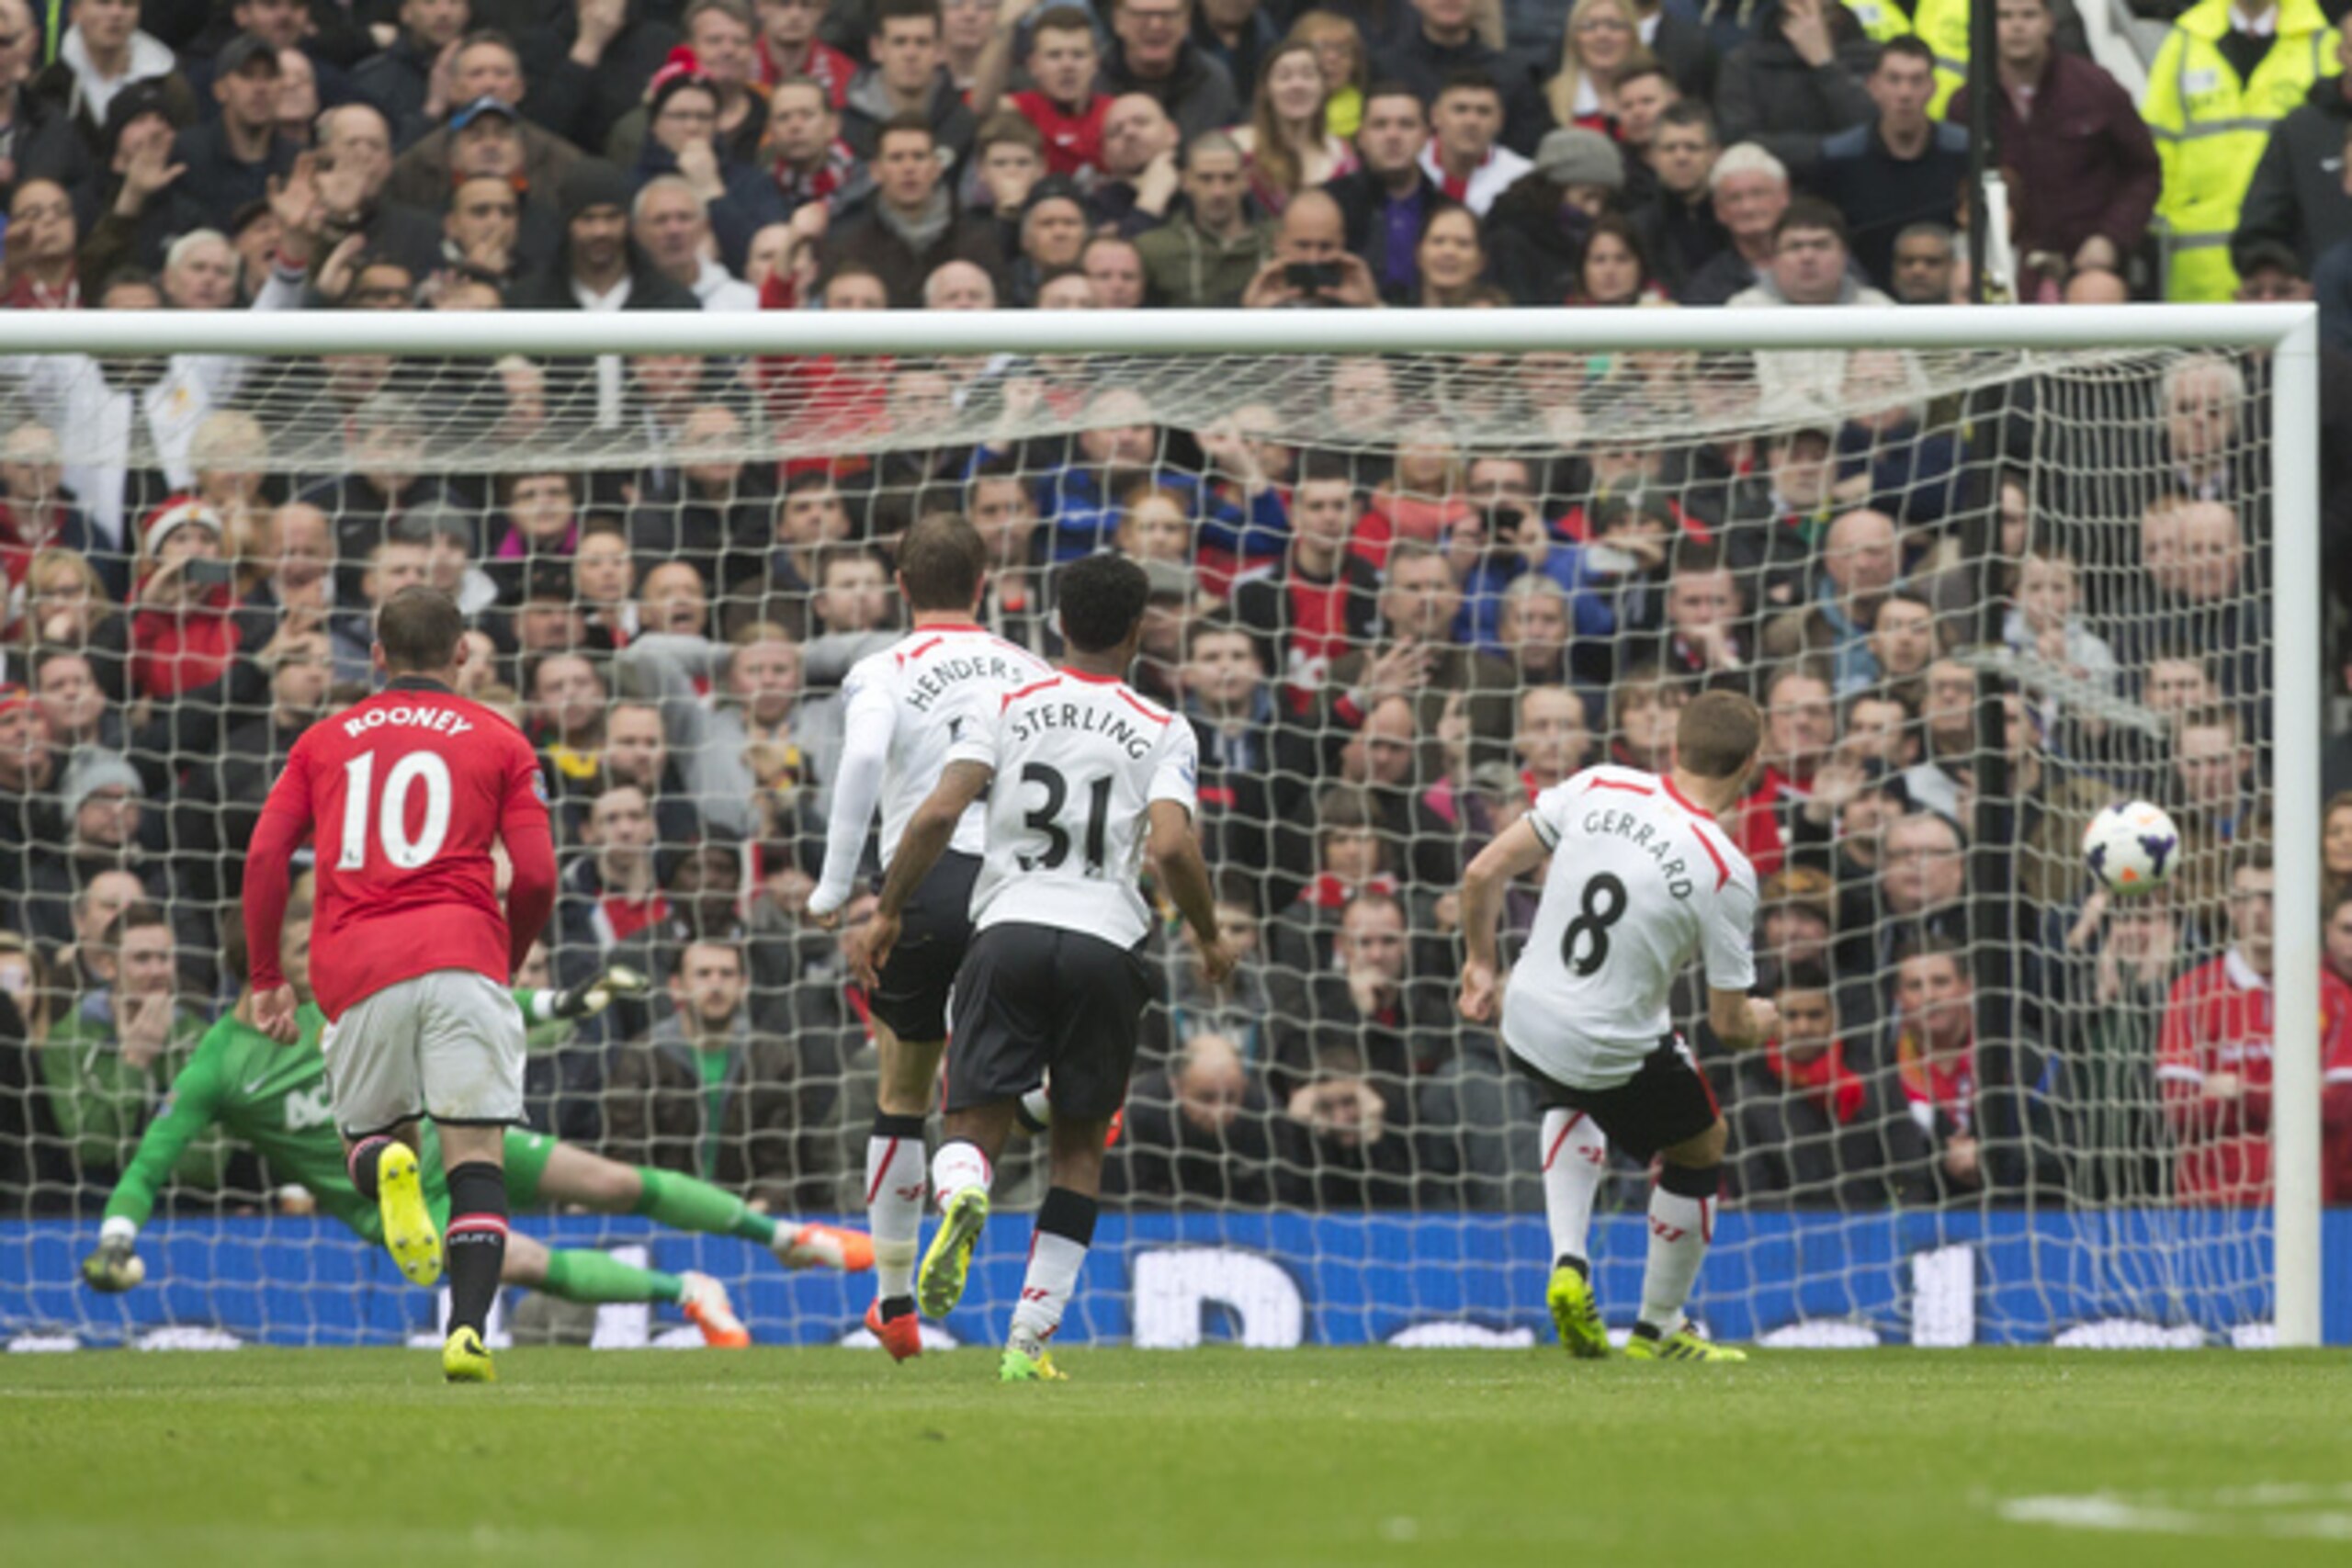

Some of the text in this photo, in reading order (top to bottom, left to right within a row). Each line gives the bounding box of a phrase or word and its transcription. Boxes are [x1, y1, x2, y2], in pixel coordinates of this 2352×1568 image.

[344, 706, 472, 738] ROONEY
[1012, 704, 1151, 760] STERLING
[336, 750, 452, 870] 10
[1016, 762, 1114, 876] 31
[1584, 809, 1692, 900] GERRARD
[1561, 871, 1628, 977] 8
